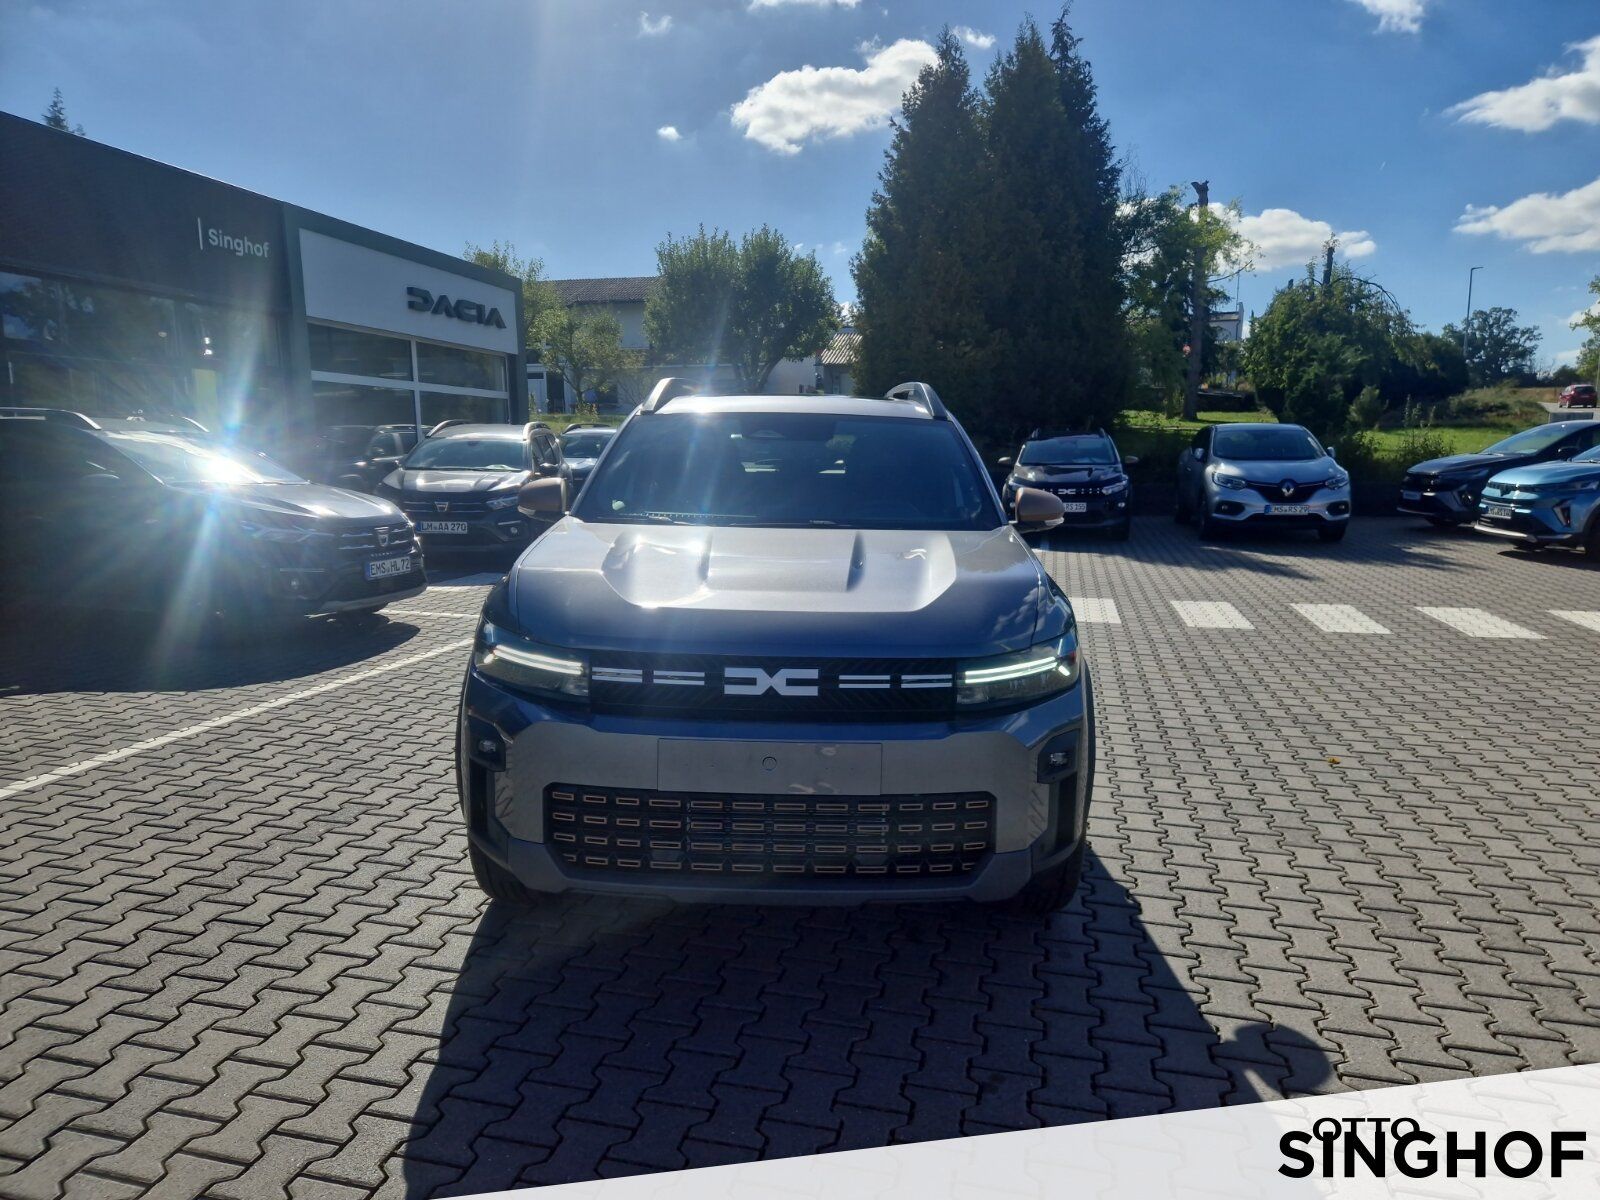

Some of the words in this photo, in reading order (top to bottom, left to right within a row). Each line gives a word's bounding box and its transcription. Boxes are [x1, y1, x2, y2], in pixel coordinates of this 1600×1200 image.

[208, 228, 269, 258] Singhof
[406, 286, 507, 329] DACIA
[450, 522, 467, 531] 270
